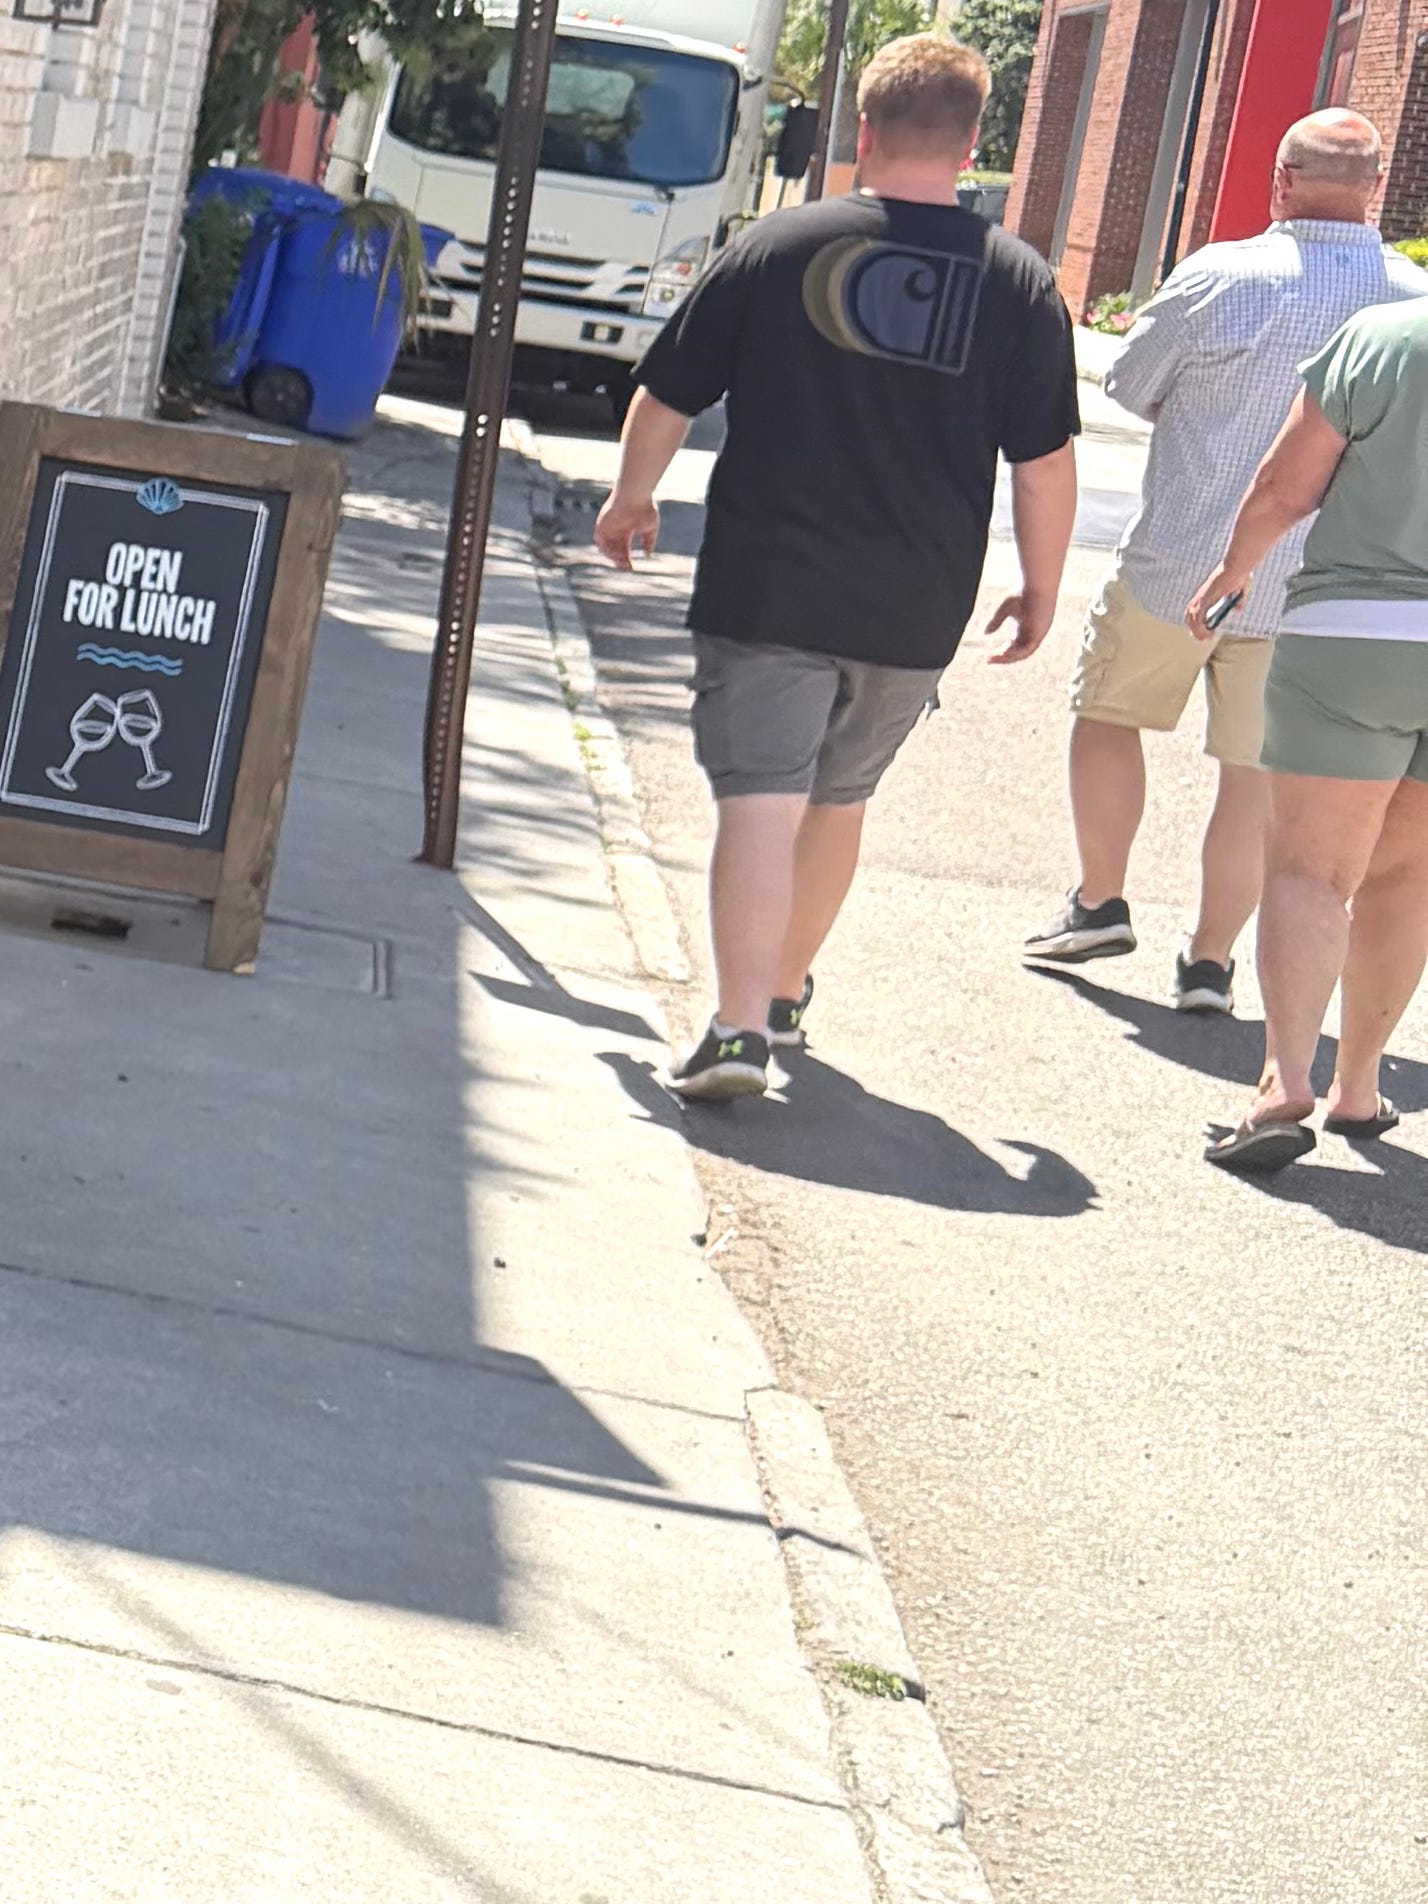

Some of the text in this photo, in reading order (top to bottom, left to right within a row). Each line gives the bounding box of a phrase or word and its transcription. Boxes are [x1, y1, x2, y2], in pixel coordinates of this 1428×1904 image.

[105, 541, 183, 594] OPEN
[62, 578, 217, 646] FOR LUNCH
